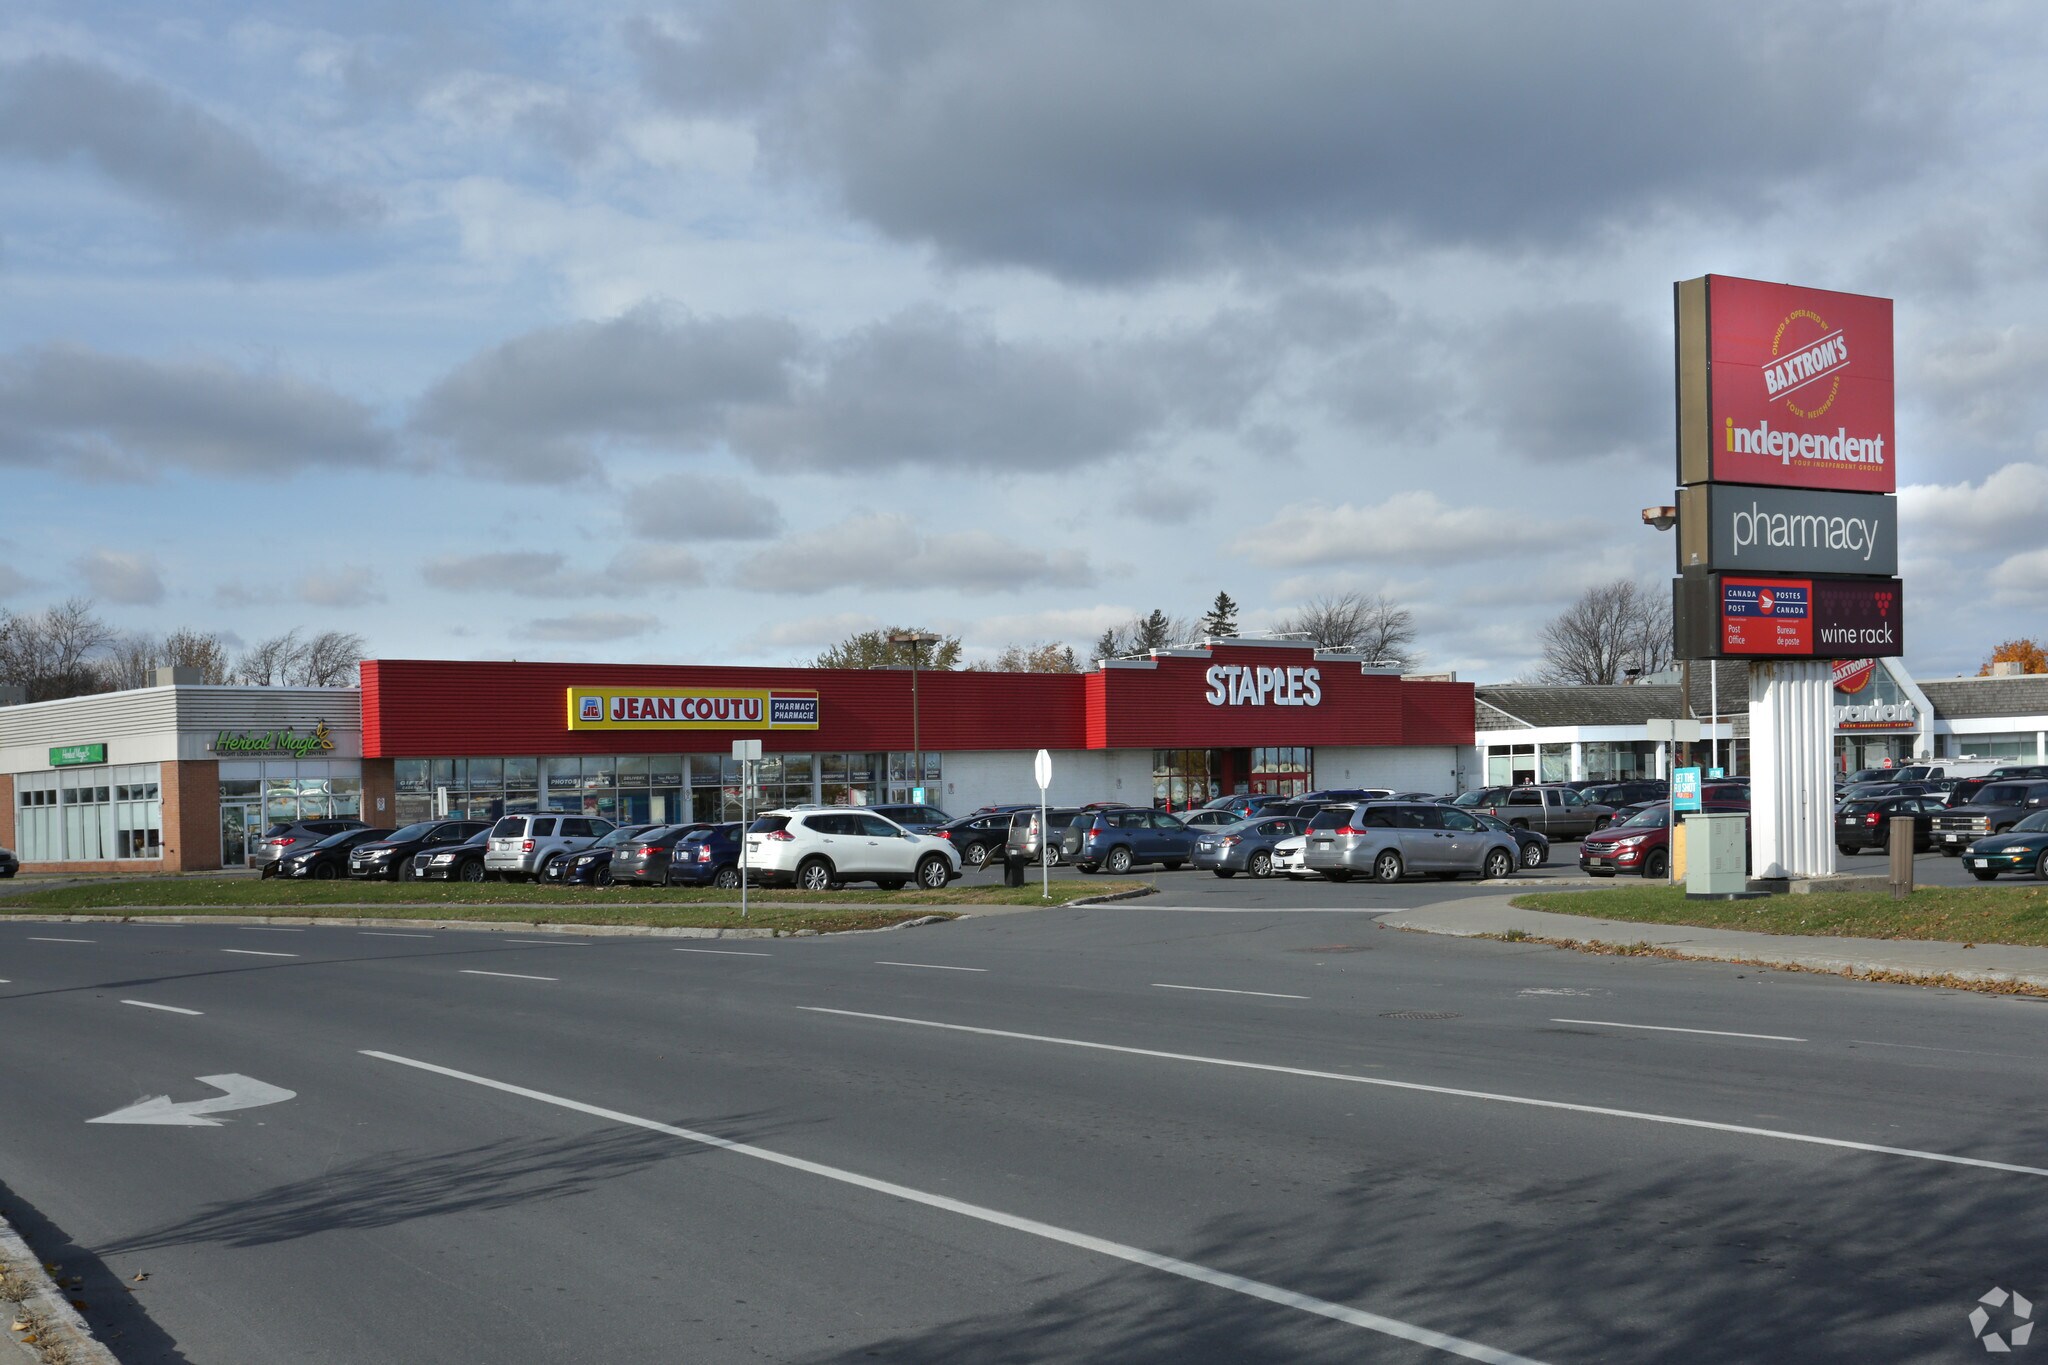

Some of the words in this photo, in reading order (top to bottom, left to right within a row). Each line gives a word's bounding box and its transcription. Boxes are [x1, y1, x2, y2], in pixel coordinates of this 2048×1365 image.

[1772, 323, 1785, 355] OWNED
[1790, 309, 1821, 324] OPERATED
[1764, 336, 1847, 394] BAXTROM'S
[1786, 399, 1804, 418] YOUR
[1808, 376, 1840, 419] NEIGHBOURS
[1725, 417, 1884, 465] independent
[1813, 461, 1856, 470] INDEPENDENT
[1858, 464, 1883, 472] GROCER
[1733, 501, 1878, 561] pharmacy
[1728, 590, 1756, 598] CANADA
[1776, 591, 1801, 600] POSTES
[1728, 604, 1745, 612] POST
[1776, 606, 1804, 614] CANADA
[1728, 624, 1740, 633] Post
[1777, 626, 1796, 635] Bureau
[1821, 622, 1857, 643] wine
[1860, 622, 1893, 644] rack
[1728, 635, 1745, 645] Office
[1777, 637, 1784, 646] de
[1784, 638, 1800, 647] poste
[1206, 664, 1322, 707] STAPLES
[613, 698, 676, 720] JEAN
[681, 698, 759, 720] COUTU
[774, 702, 814, 710] PHARMACY
[774, 711, 814, 719] PHARMACIE
[1833, 698, 1914, 728] pendent
[216, 730, 273, 750] Herbal
[276, 730, 322, 758] Magic
